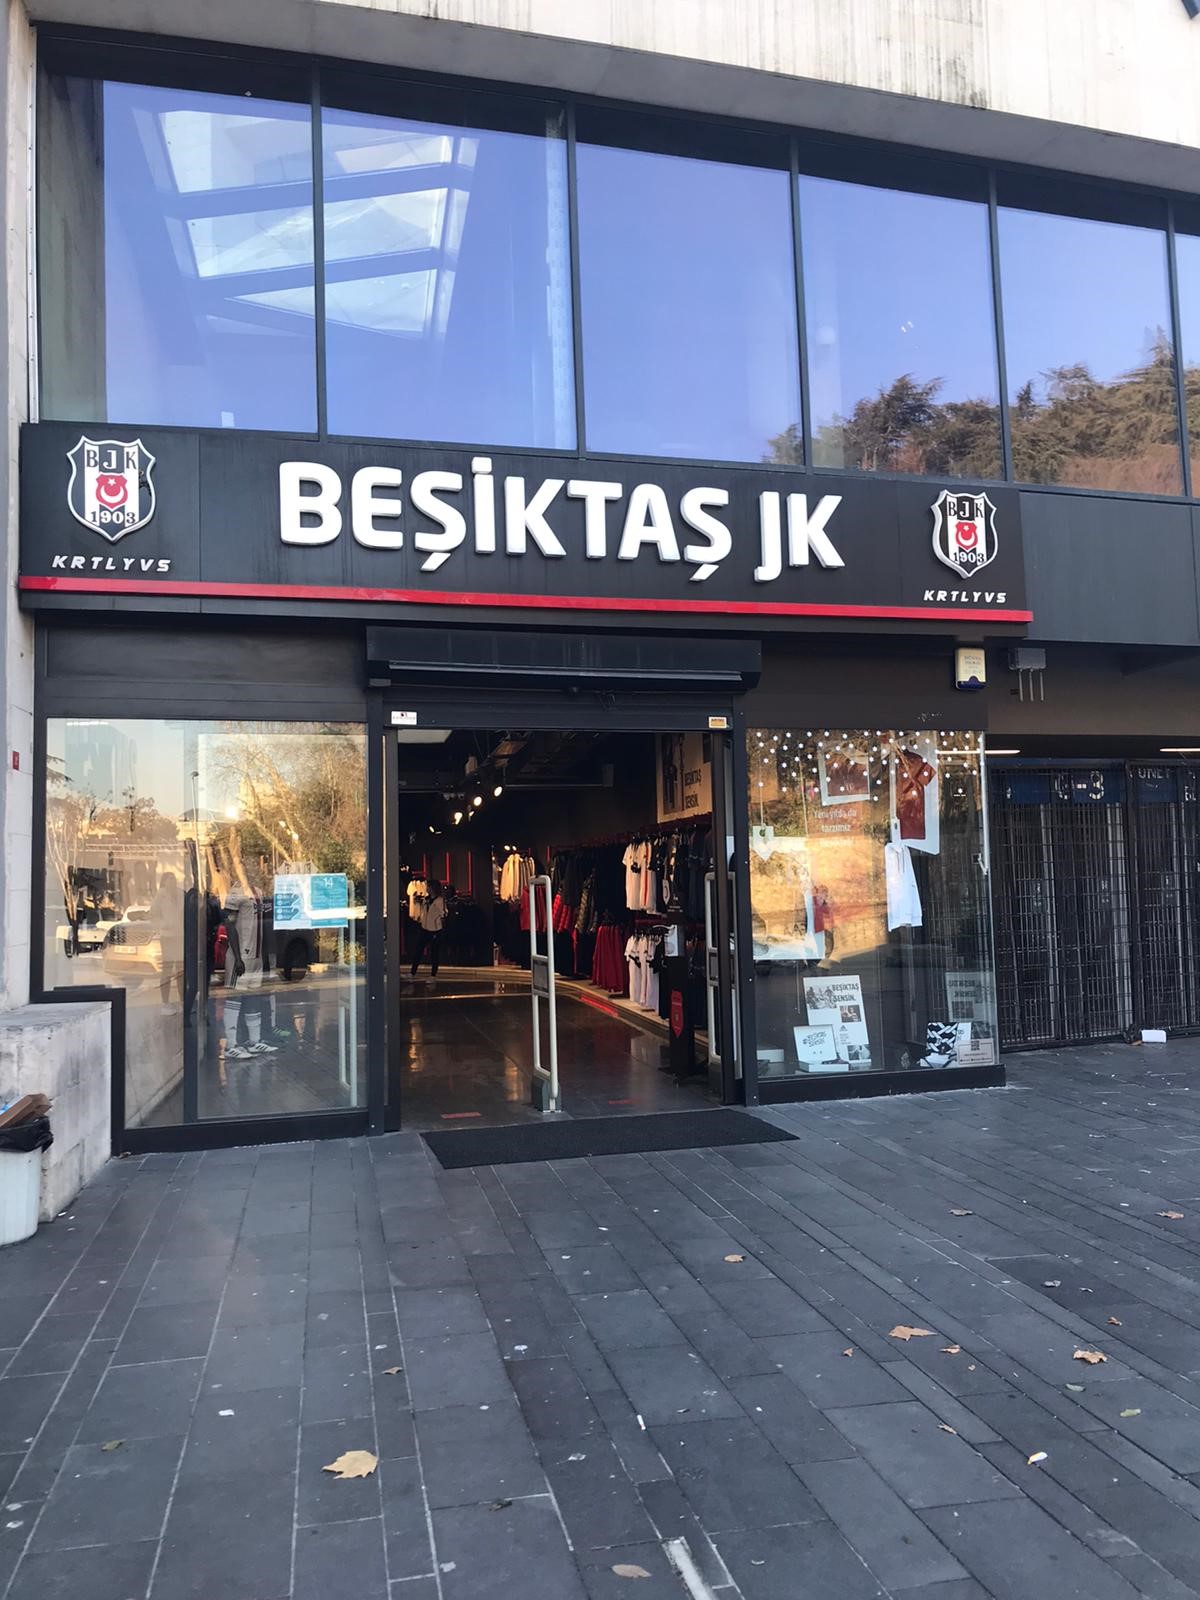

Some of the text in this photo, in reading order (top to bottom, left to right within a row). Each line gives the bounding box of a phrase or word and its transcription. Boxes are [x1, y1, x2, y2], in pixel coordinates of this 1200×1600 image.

[86, 449, 137, 469] BJK
[90, 511, 136, 524] 1903
[948, 501, 984, 518] BJK
[279, 457, 846, 582] BEŞİKTAŞ JK
[51, 555, 171, 572] KRTLYVS
[953, 551, 985, 564] 1903
[923, 590, 1007, 604] KRTLYVS
